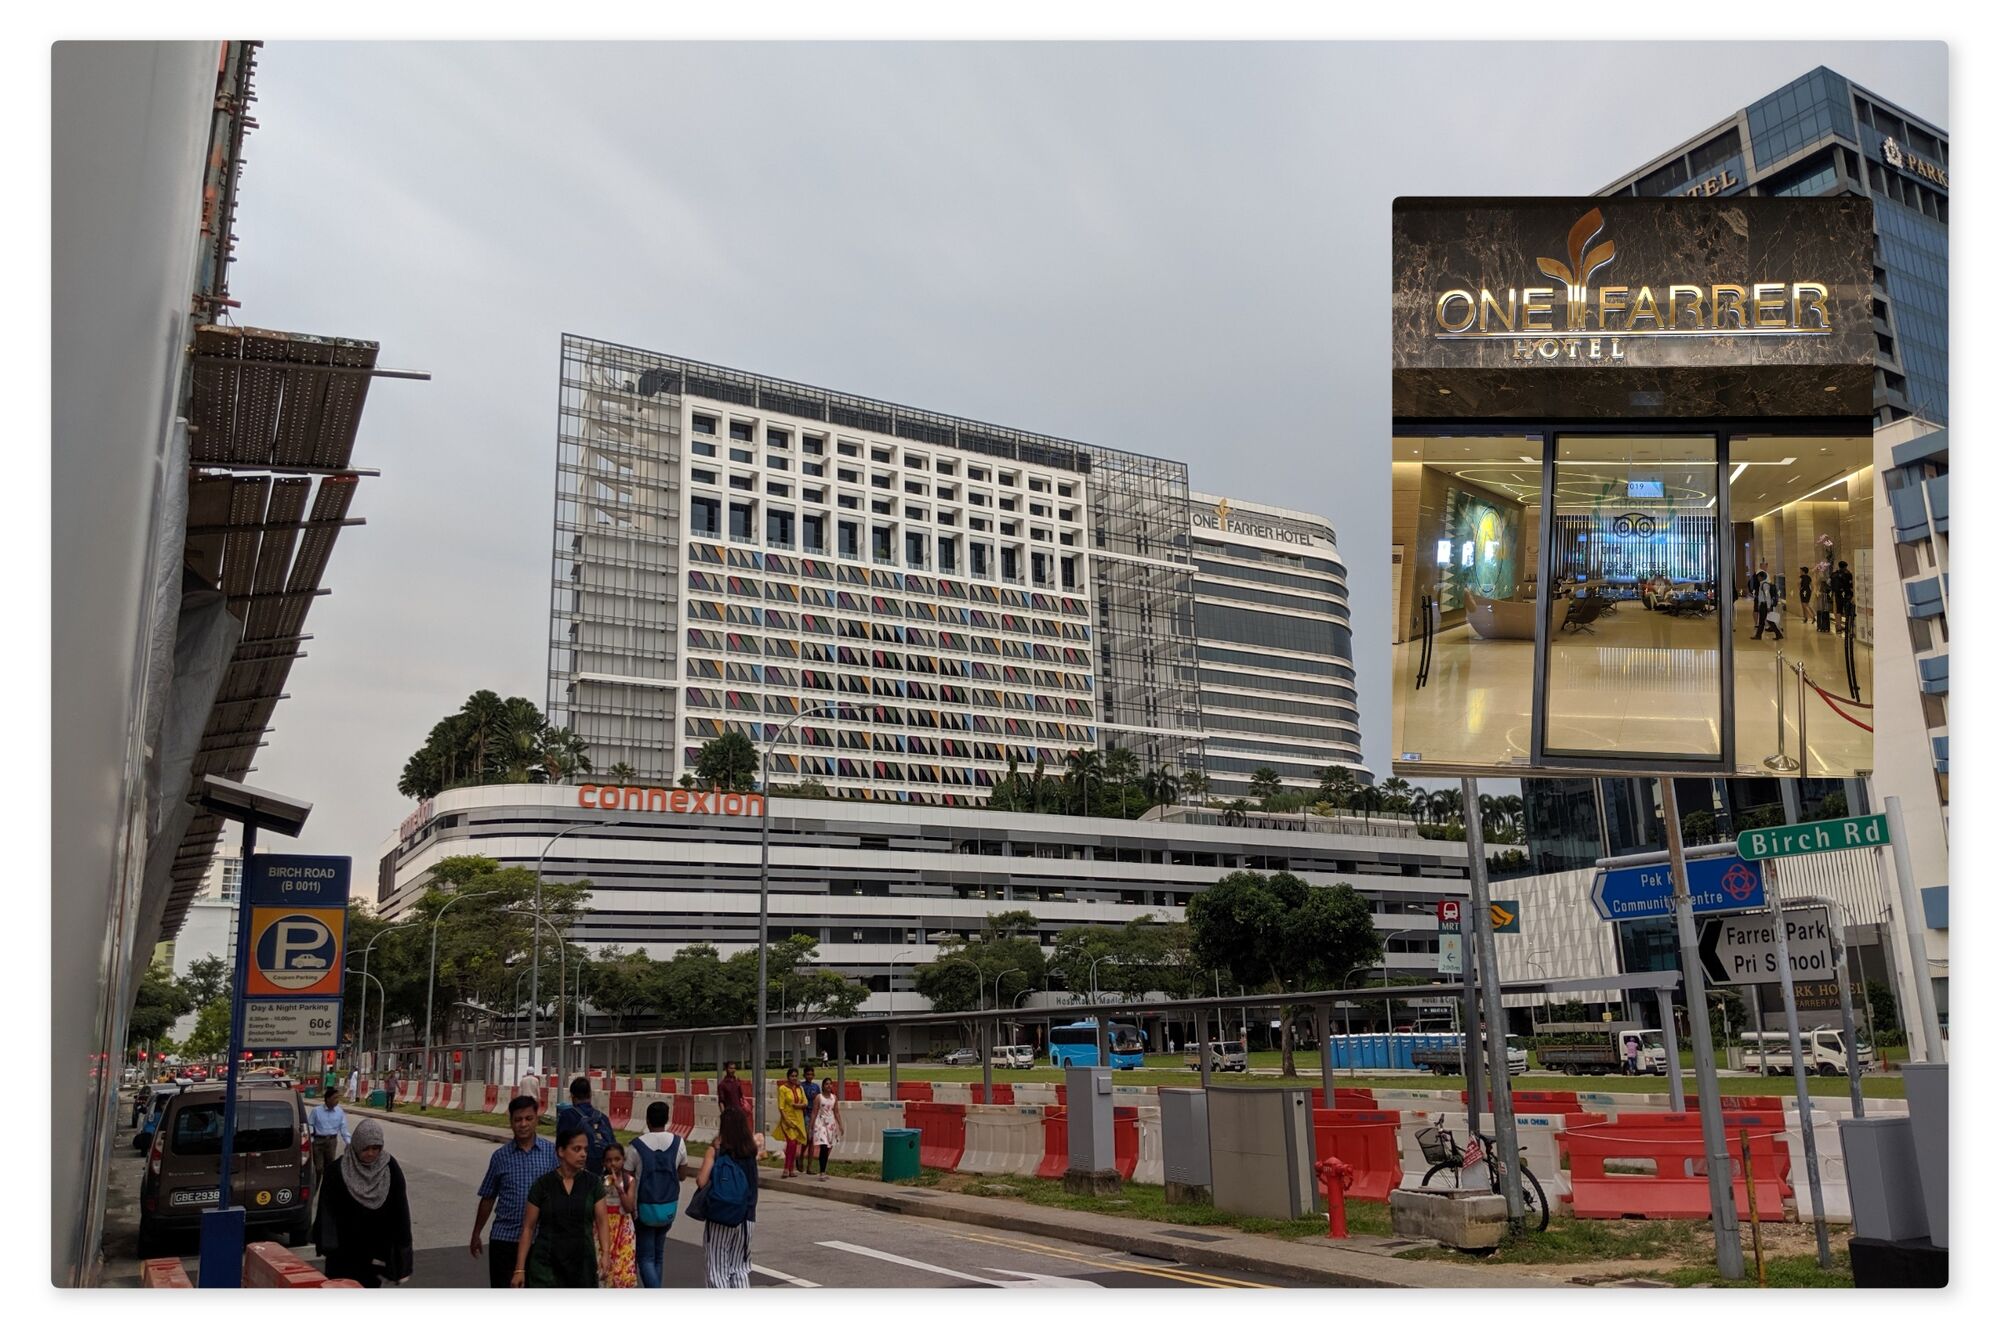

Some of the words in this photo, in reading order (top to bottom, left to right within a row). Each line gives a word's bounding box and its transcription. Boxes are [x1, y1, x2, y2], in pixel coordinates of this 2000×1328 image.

[1907, 152, 1948, 188] PARK
[1677, 171, 1738, 197] TEL
[1435, 288, 1555, 333] ONE
[1599, 282, 1832, 331] FARRER
[1512, 337, 1627, 360] HOTEL
[1193, 513, 1219, 530] ONE
[1227, 520, 1273, 540] FARRER
[1276, 528, 1314, 547] HOTEL
[578, 785, 764, 816] connexion
[1751, 826, 1831, 856] Birch
[1843, 819, 1880, 845] Rd
[268, 866, 302, 878] BIRCH
[304, 868, 336, 879] ROAD
[1641, 873, 1663, 887] Pek
[281, 881, 293, 893] (B
[296, 881, 321, 893] 0011)
[1613, 895, 1677, 913] Community
[1690, 891, 1723, 906] entre
[1442, 922, 1460, 931] MRT
[1786, 920, 1827, 941] Park
[275, 921, 329, 970] P
[1734, 953, 1757, 974] Pri
[1765, 950, 1826, 972] Shool
[1819, 983, 1864, 996] HOEL
[251, 1004, 266, 1012] Day
[276, 1004, 297, 1012] Night
[299, 1004, 329, 1012] Parking
[309, 1018, 332, 1030] 60¢
[279, 1191, 290, 1199] 70
